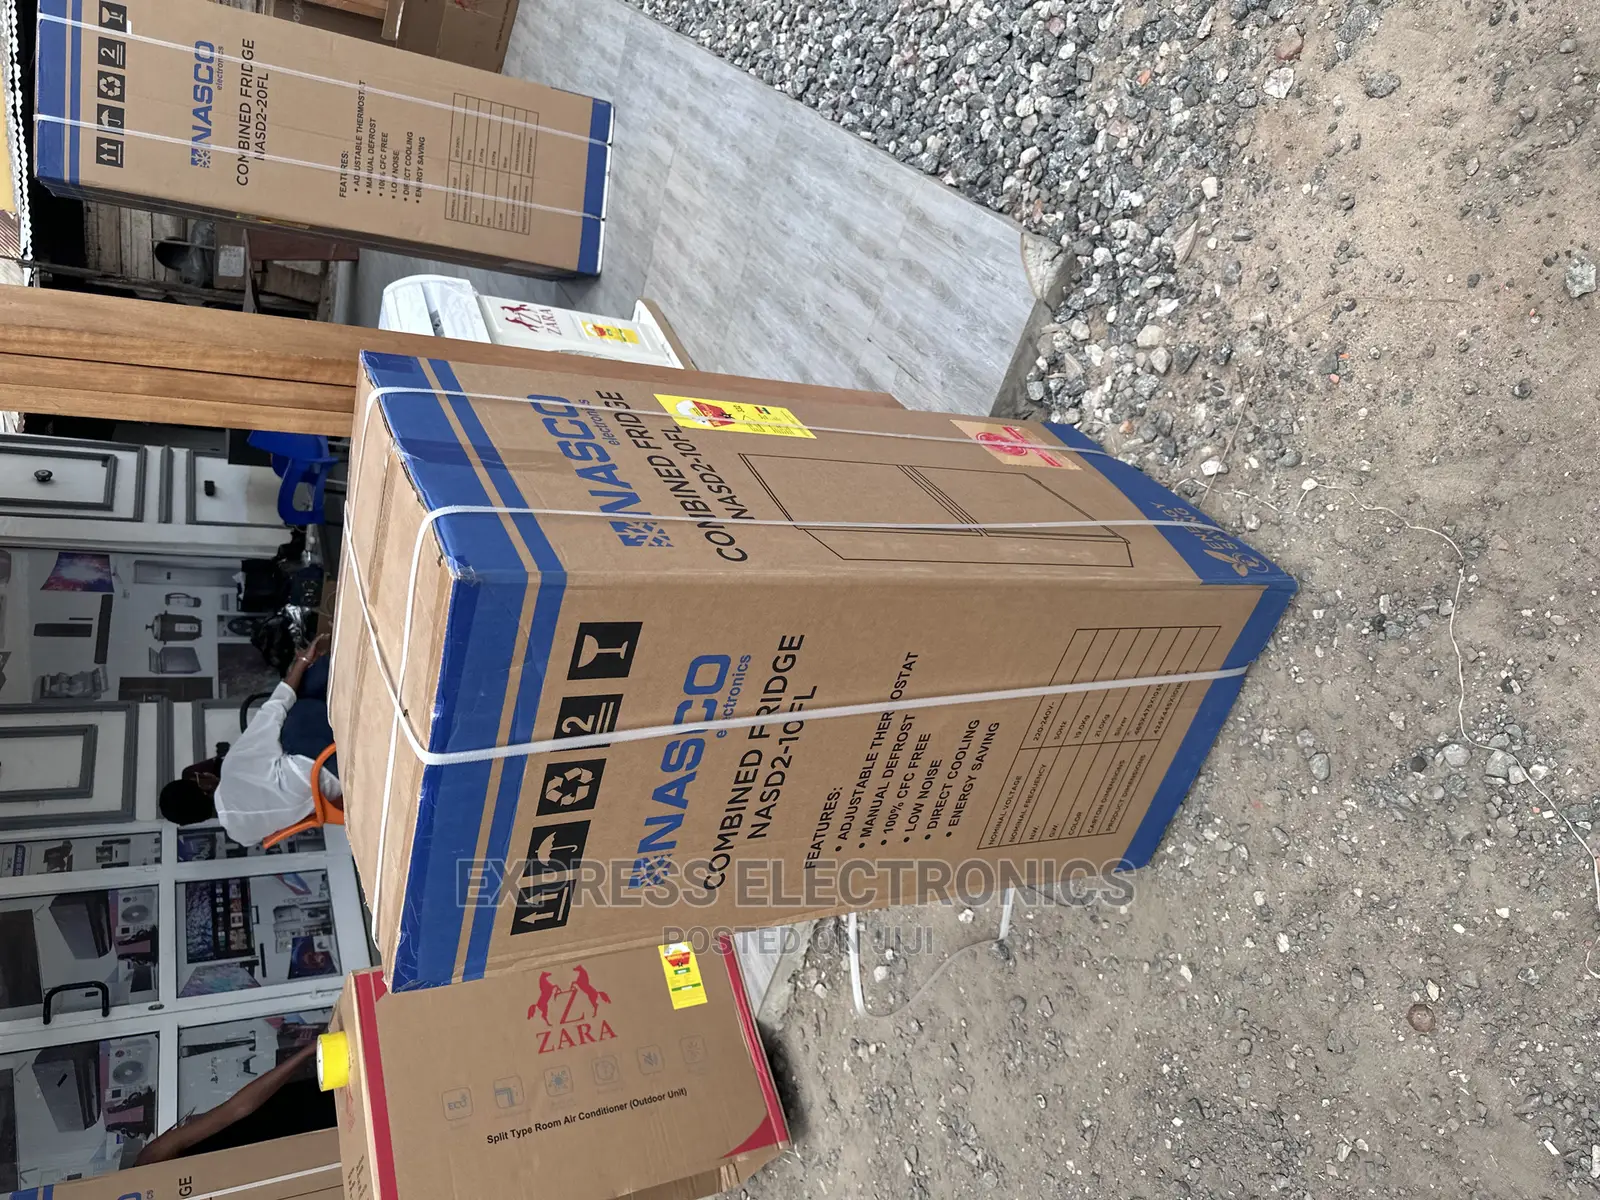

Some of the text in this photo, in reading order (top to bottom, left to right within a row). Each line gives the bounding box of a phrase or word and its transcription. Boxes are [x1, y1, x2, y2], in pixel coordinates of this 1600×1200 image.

[192, 40, 215, 148] NASCO
[214, 46, 224, 91] electroncs
[236, 38, 254, 186] COMBINED FRIDGE
[255, 73, 268, 160] NASD2-20FL
[353, 80, 366, 186] ADUSTABLE THERMOSTT
[368, 118, 377, 154] DEFROST
[404, 132, 414, 166] COOLING
[380, 154, 388, 170] CFC
[392, 150, 400, 174] NOISE
[415, 136, 426, 198] ENRGY SAVING
[540, 309, 562, 336] ZARA
[526, 394, 651, 516] NASCO
[577, 400, 620, 446] electronis
[596, 390, 748, 562] COMBINED FRIDGE
[660, 425, 755, 520] NASD2-10FL
[1173, 508, 1240, 550] SAVNG
[715, 654, 751, 738] ectronics
[636, 654, 731, 854] NASCO
[703, 634, 804, 890] COMBINED FRIDGE
[837, 652, 918, 840] ADJUSTABLE THEROSTAT
[860, 714, 916, 838] MANUAL DEFROST
[883, 733, 931, 834] 100% CFC FREE
[926, 719, 980, 830] DIRECT COOLING
[948, 722, 1000, 826] ENERGY SAVING
[804, 786, 842, 869] FEATURES:
[904, 760, 942, 832] LOW NOISE
[988, 811, 1007, 846] NOMINAL
[1002, 775, 1022, 810] VOLTAGE
[1008, 810, 1028, 842] NOMINAL
[1023, 764, 1047, 808] FREQUENCY
[1068, 811, 1083, 836] COLOR
[1087, 804, 1104, 834] CARTON
[1101, 760, 1126, 803] DIMENSIONS
[1106, 799, 1126, 832] PRODUCT
[1121, 754, 1146, 798] DIMENSIONS
[536, 1019, 618, 1055] ZARA
[486, 1131, 508, 1145] Split
[510, 1124, 533, 1139] Type
[535, 1118, 562, 1132] Room
[564, 1114, 577, 1125] Air
[578, 1102, 628, 1121] Conditioner
[629, 1091, 666, 1110] (Outdoor
[667, 1087, 688, 1100] Unit)
